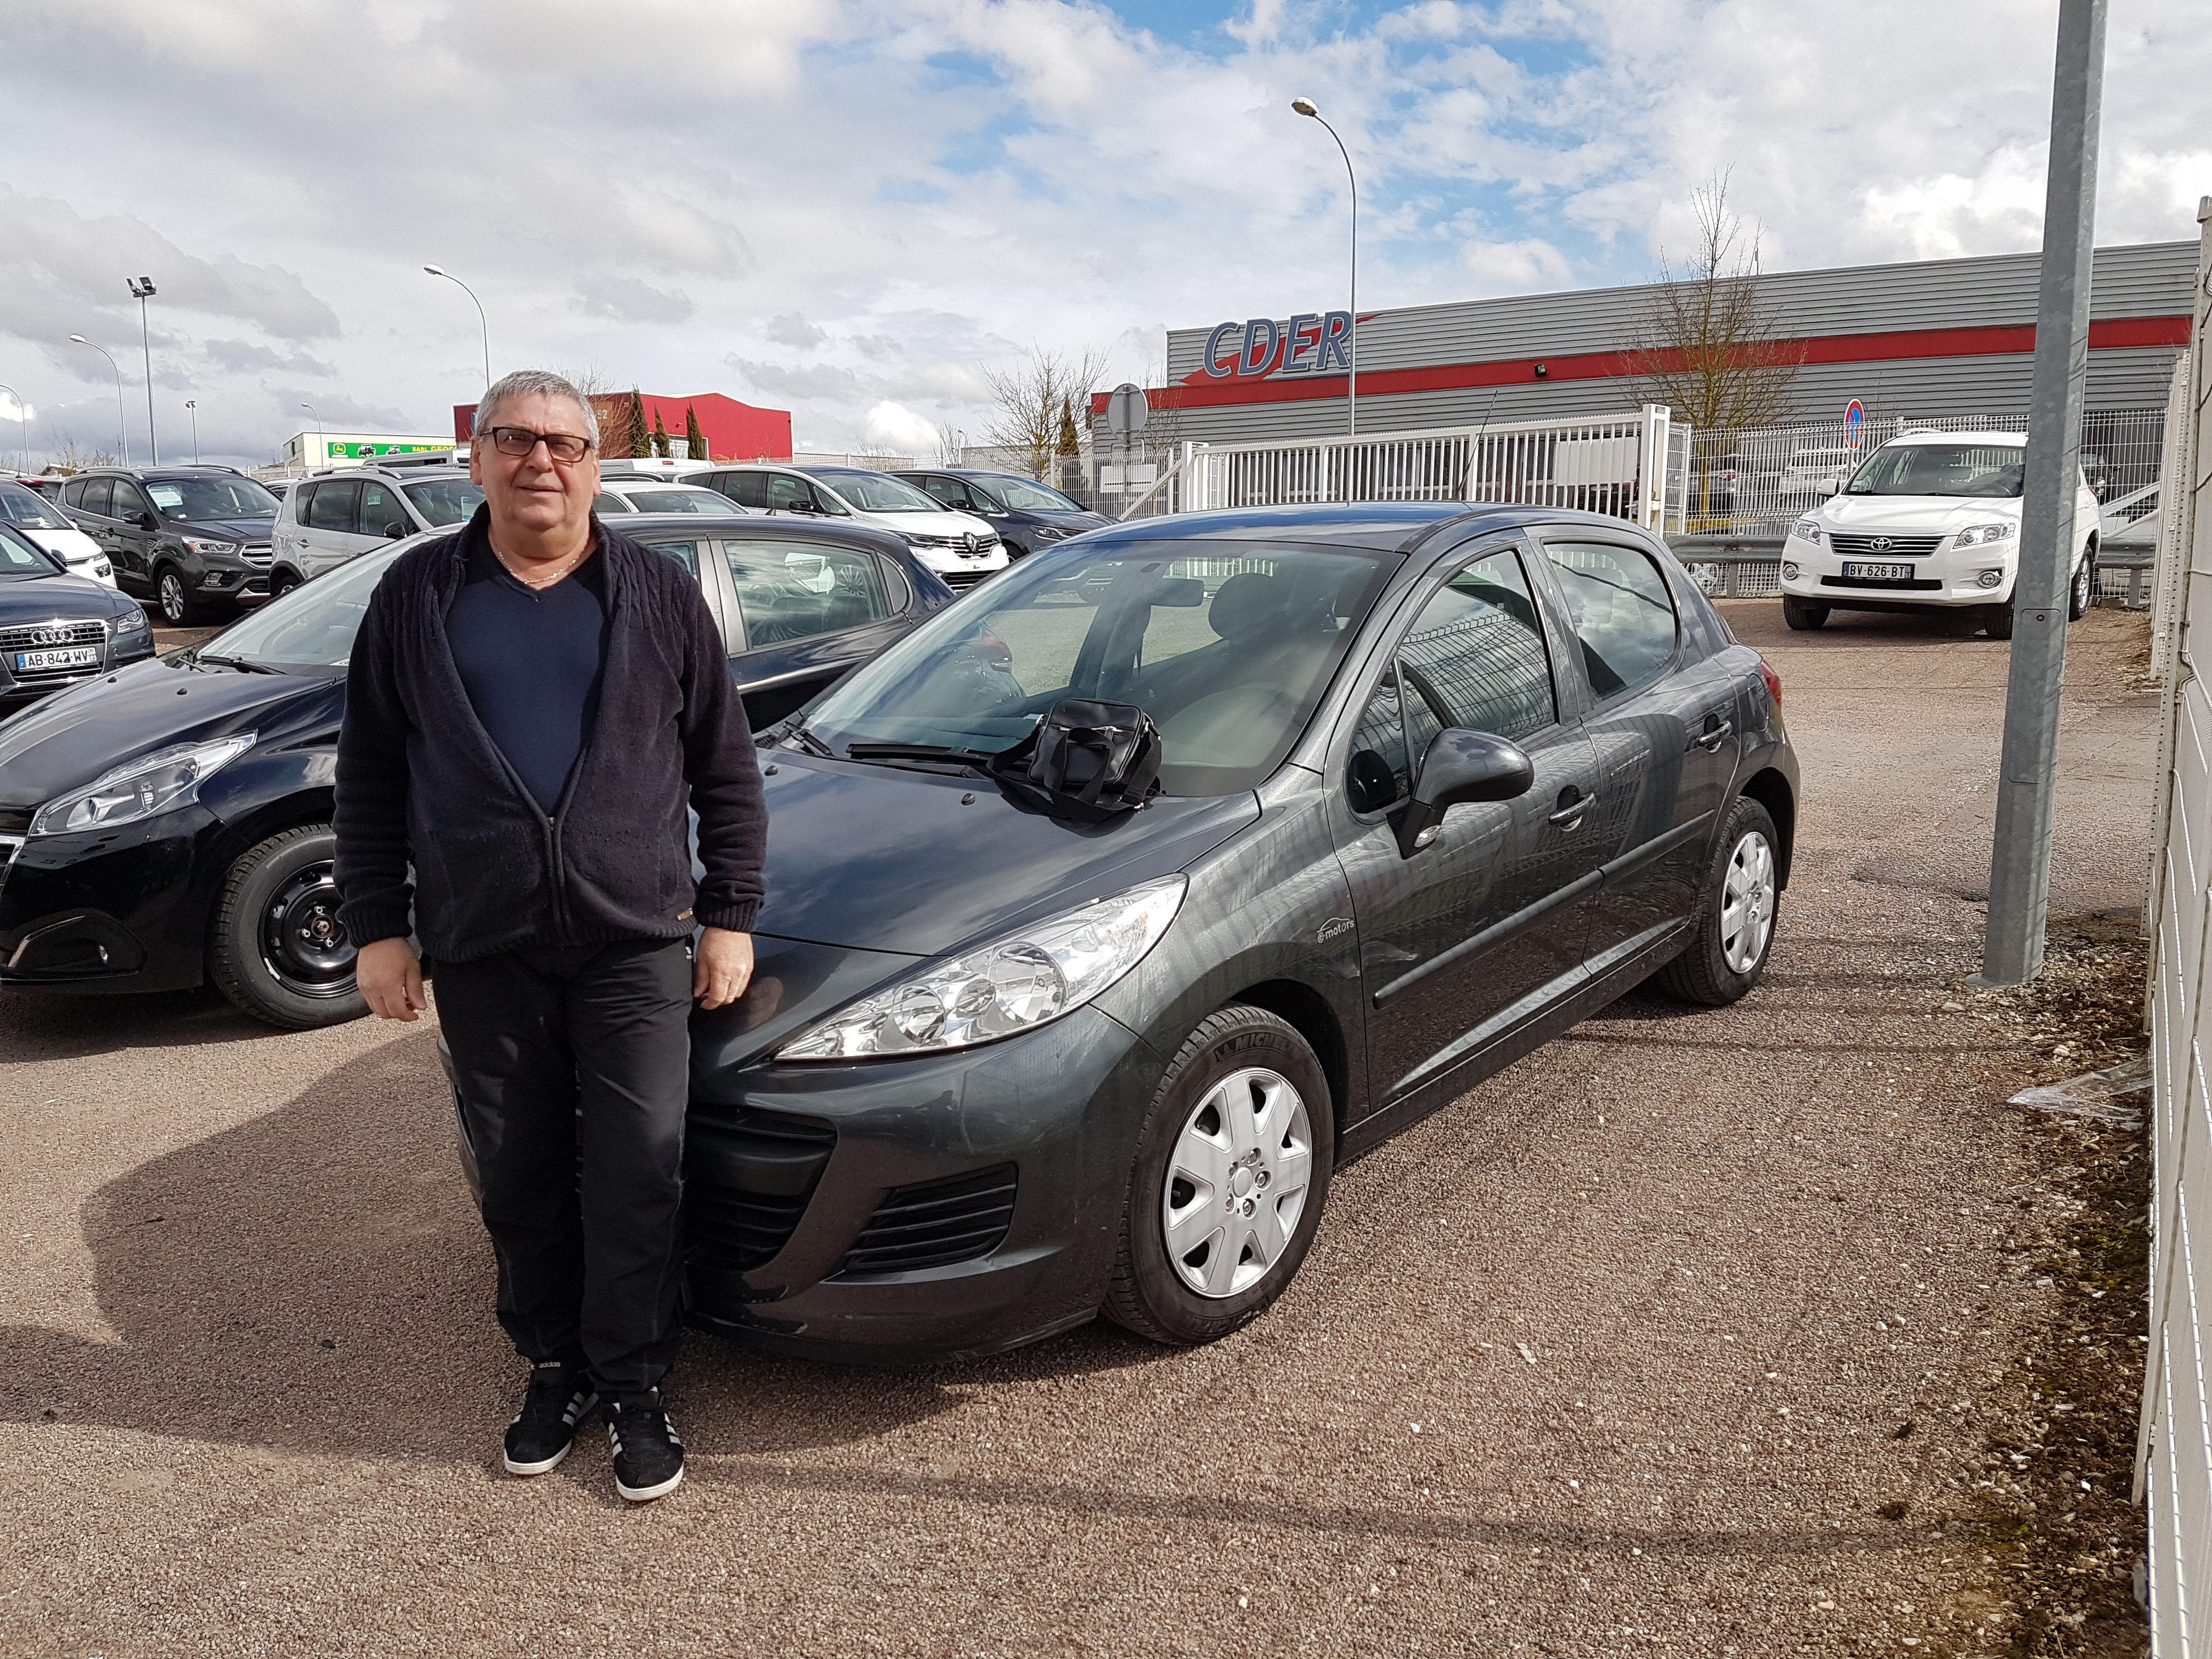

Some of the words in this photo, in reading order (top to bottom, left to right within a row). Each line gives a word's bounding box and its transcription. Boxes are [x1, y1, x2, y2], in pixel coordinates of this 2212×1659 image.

[1203, 311, 1352, 378] CDER
[1850, 565, 1905, 578] BV-626-BT
[28, 650, 88, 667] AB-842-WV
